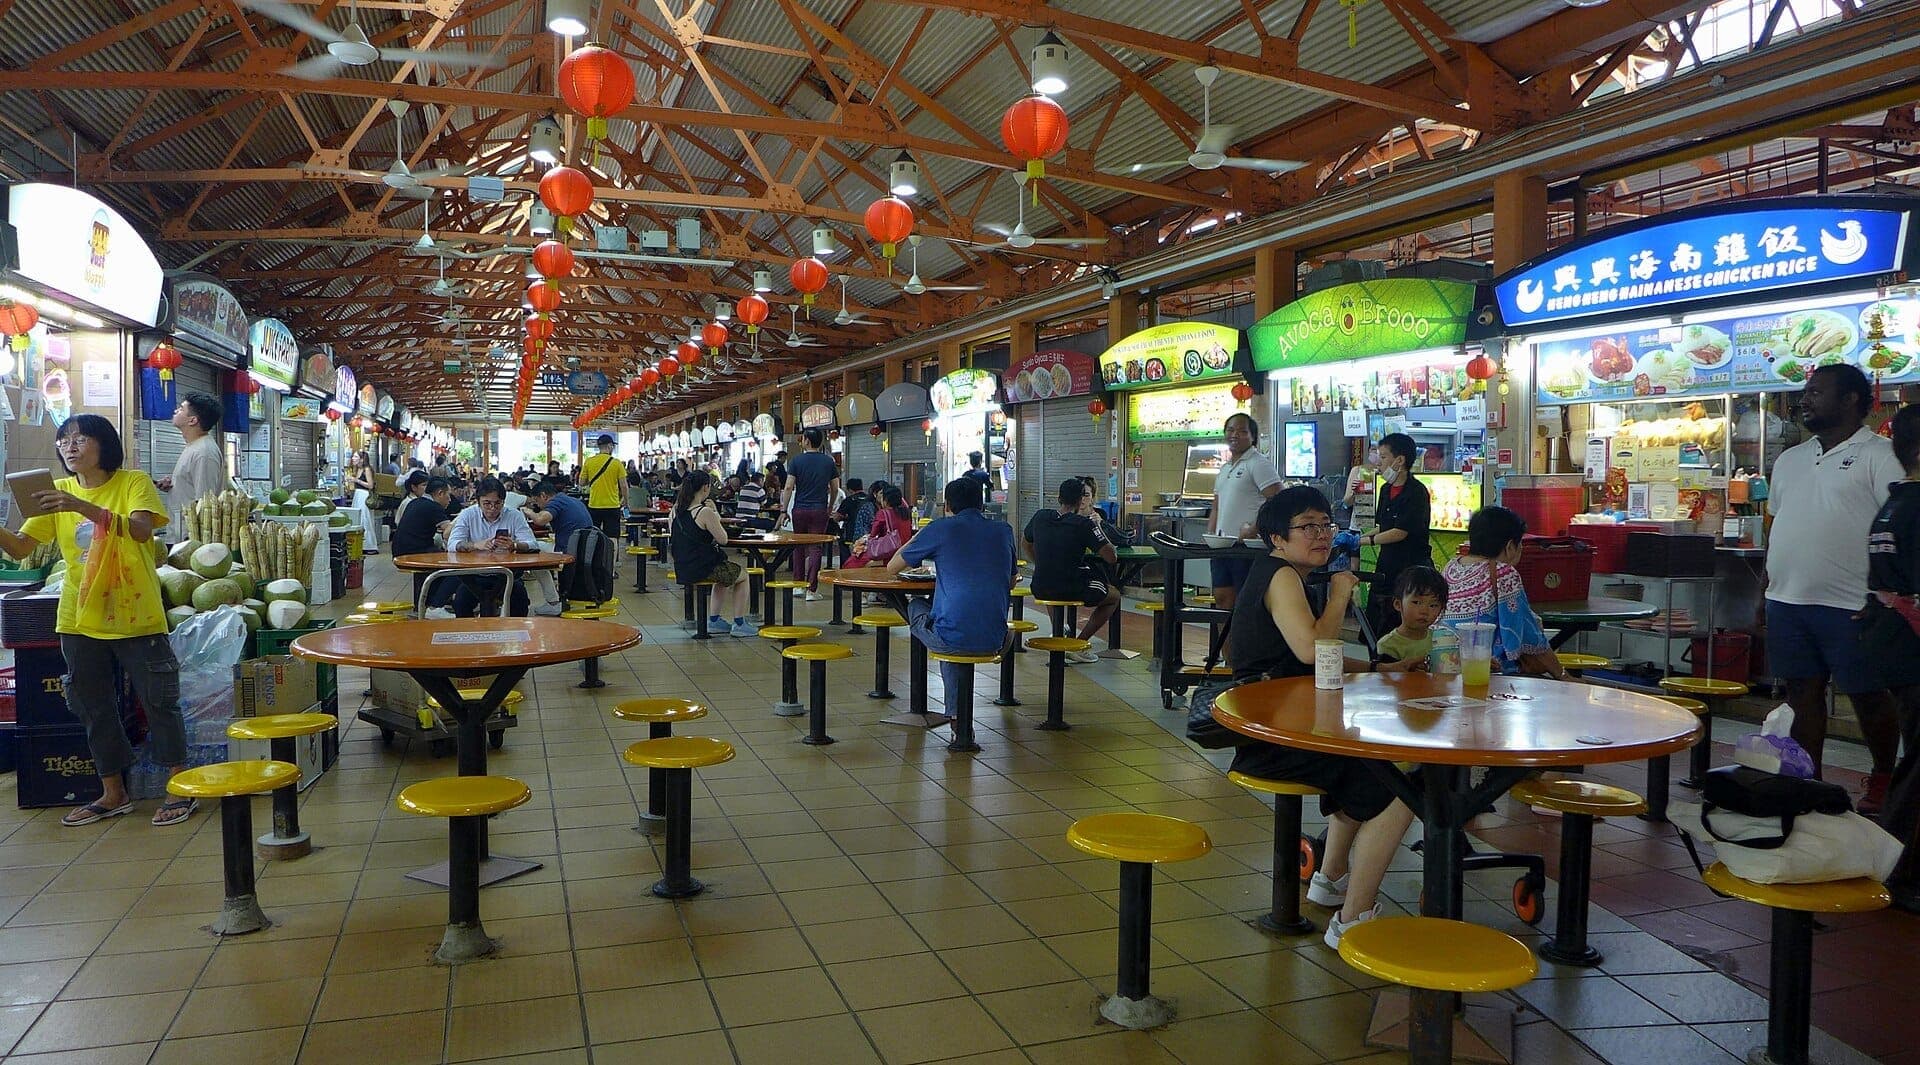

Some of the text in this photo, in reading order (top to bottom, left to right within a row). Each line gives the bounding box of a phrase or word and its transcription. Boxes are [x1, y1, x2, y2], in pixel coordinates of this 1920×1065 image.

[1547, 255, 1819, 312] HENG HENG HAINANESE CHICKEN RICE
[1360, 297, 1429, 339] Brooo
[1461, 414, 1480, 422] WAITING
[43, 755, 96, 776] Tiger
